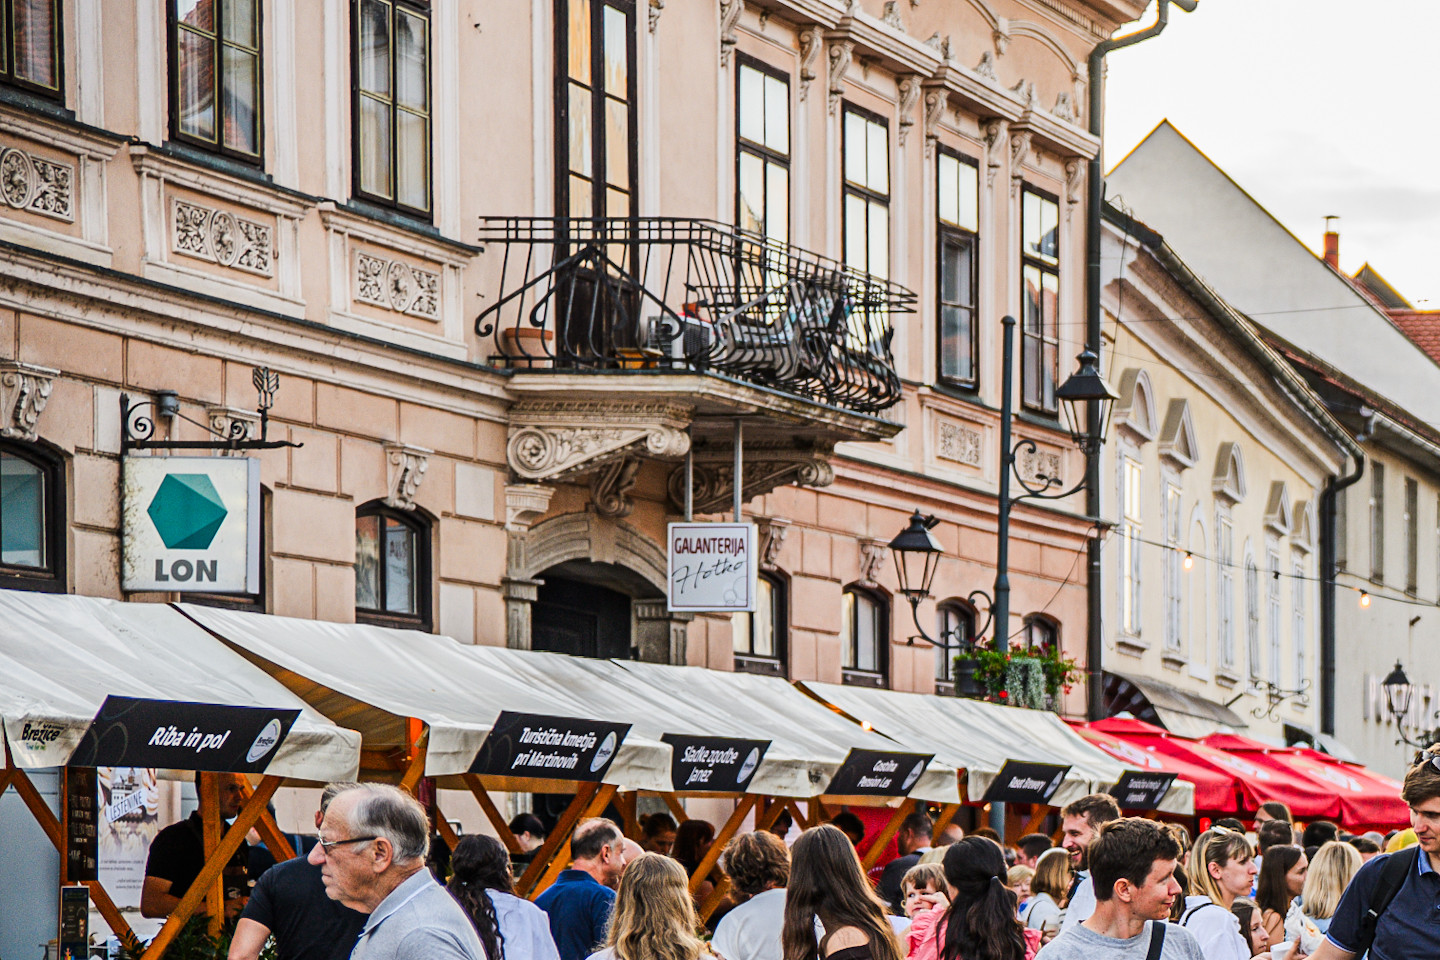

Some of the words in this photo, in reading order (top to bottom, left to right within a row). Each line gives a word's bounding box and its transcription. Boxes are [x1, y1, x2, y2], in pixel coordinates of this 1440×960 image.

[674, 537, 745, 557] GALANTERIJA
[155, 559, 217, 582] LON
[147, 725, 186, 746] Riba
[182, 727, 203, 748] in
[195, 730, 232, 753] pol
[519, 727, 563, 746] Turistična
[561, 730, 597, 752] kmetija
[511, 749, 533, 769] pri
[527, 750, 579, 769] Martinovih
[681, 745, 709, 762] Sladke
[706, 747, 739, 767] zgodbe
[685, 766, 713, 785] Janez
